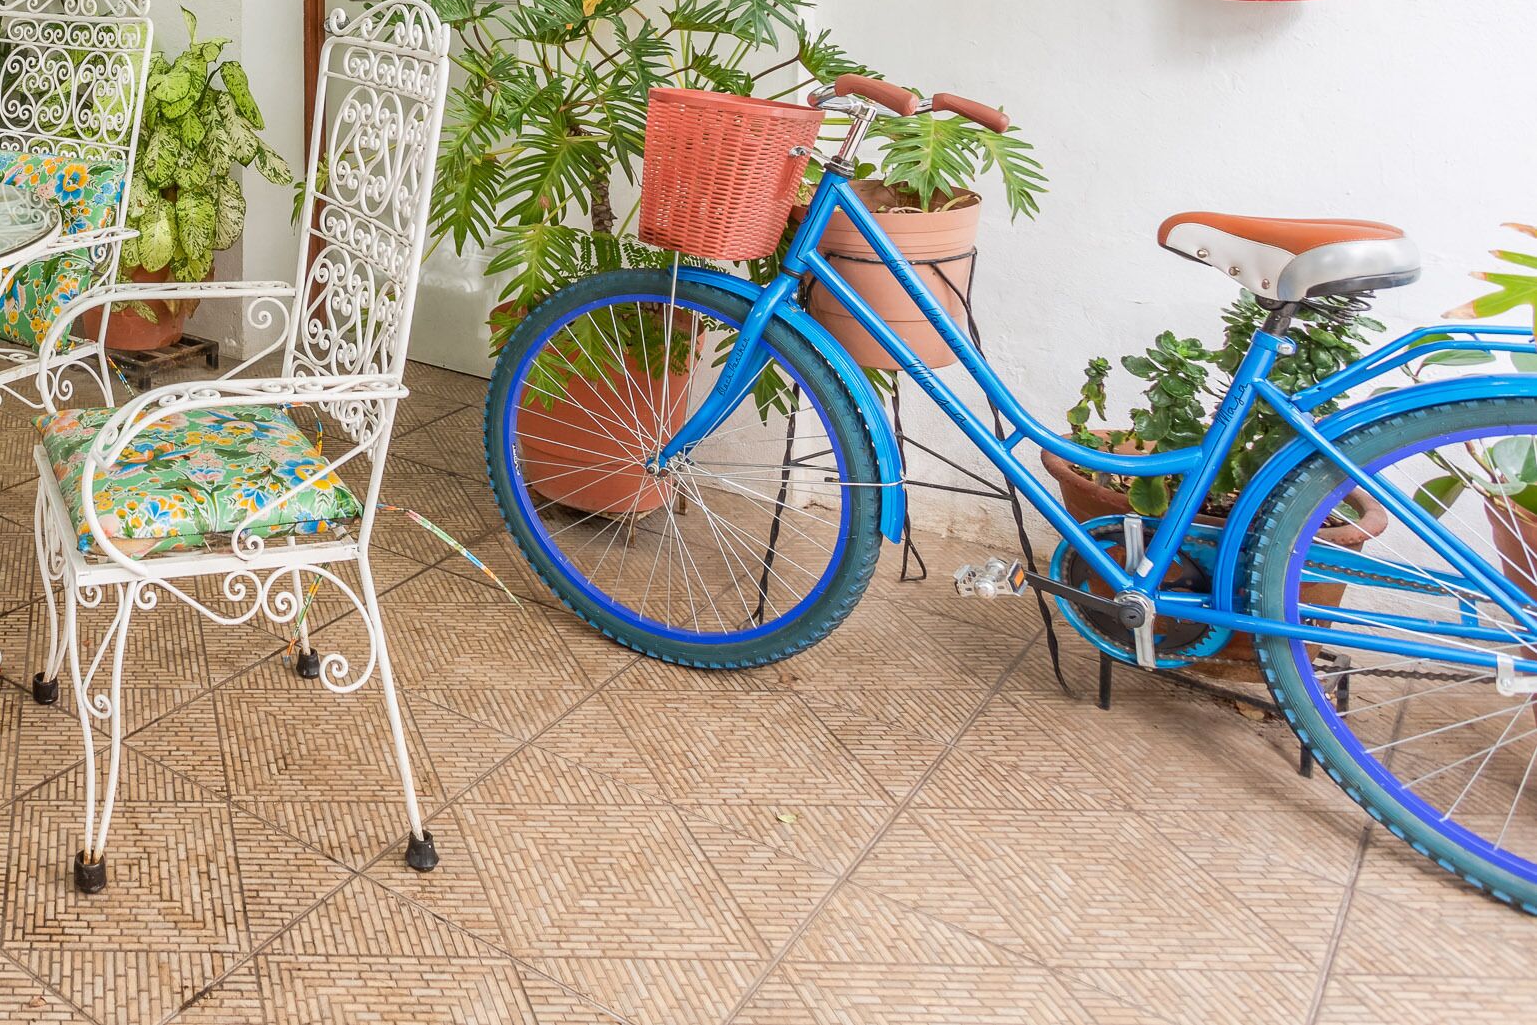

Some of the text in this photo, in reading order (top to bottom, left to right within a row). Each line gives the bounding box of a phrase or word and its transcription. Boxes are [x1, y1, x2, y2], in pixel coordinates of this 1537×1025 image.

[888, 258, 978, 375] Black Panther
[717, 336, 751, 396] Black Panther
